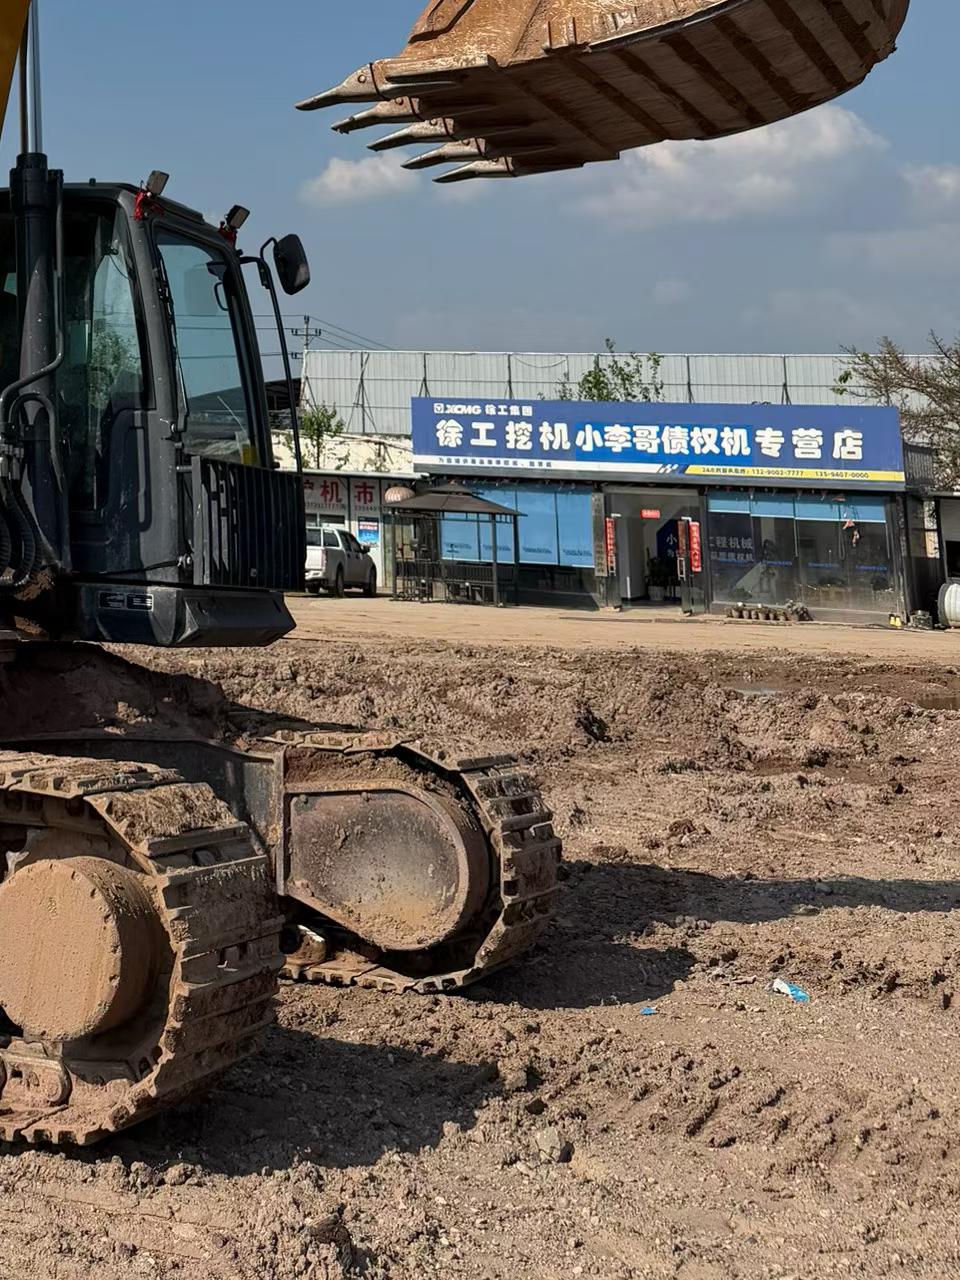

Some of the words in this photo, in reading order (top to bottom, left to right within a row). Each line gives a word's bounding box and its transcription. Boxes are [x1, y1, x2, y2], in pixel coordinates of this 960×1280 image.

[445, 404, 482, 415] XCMG
[485, 403, 533, 417] 徐工集团
[435, 418, 864, 460] 徐工挖机小李哥债权机专营店
